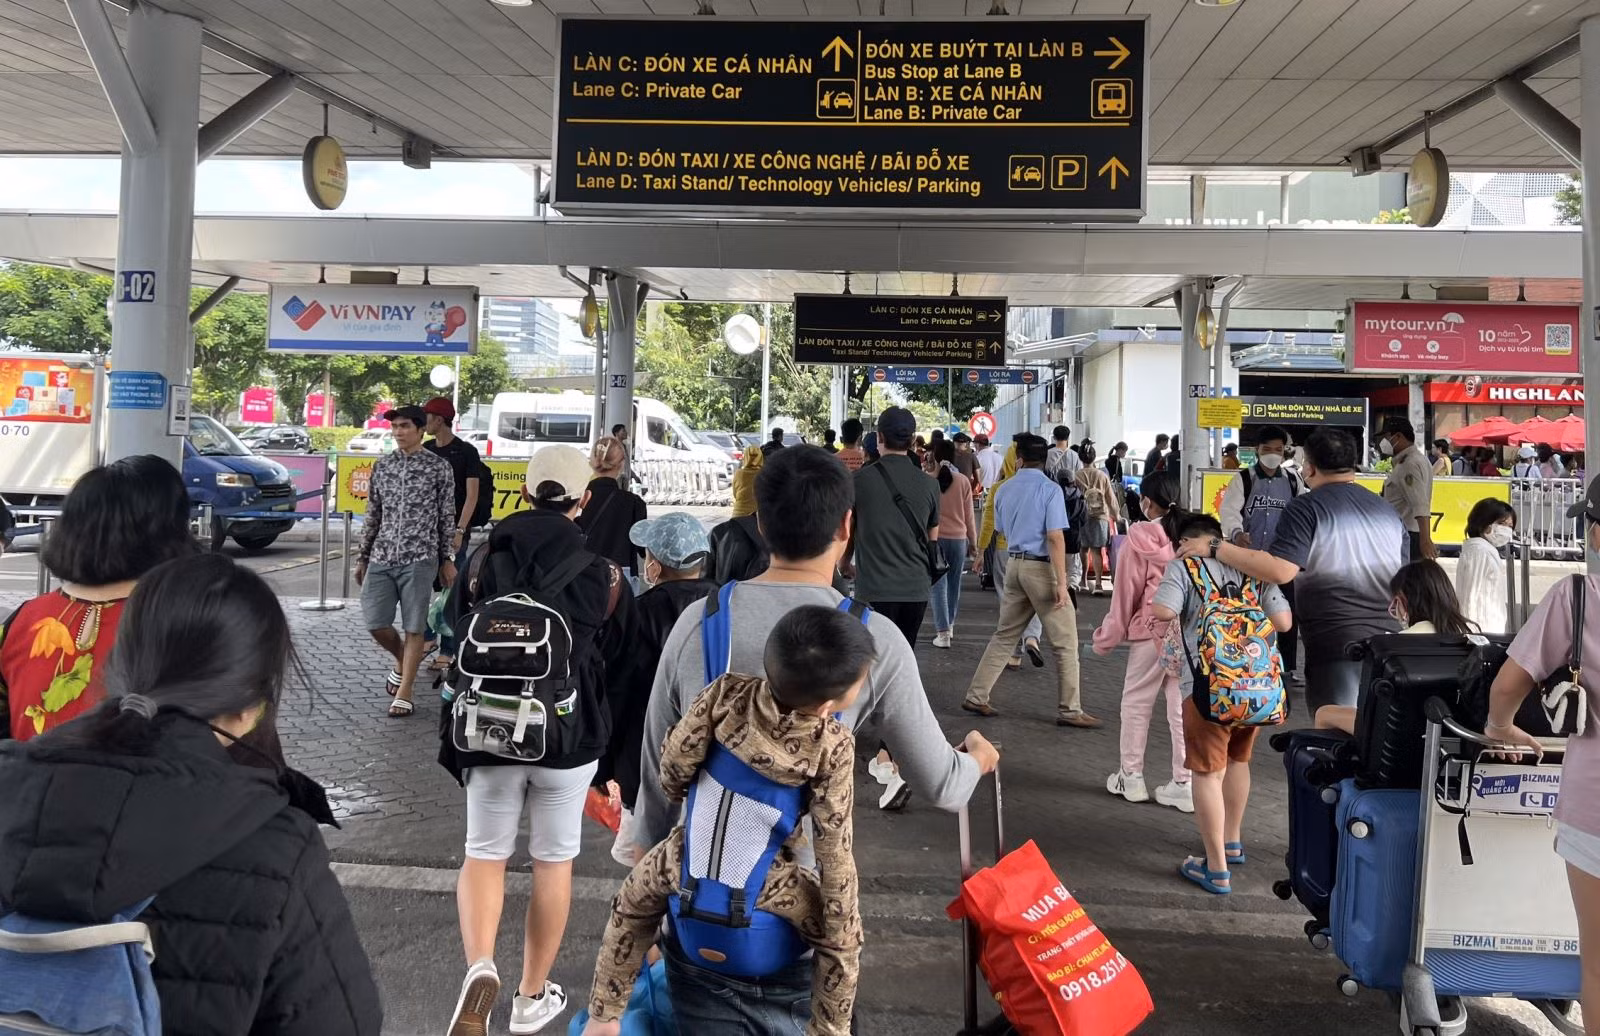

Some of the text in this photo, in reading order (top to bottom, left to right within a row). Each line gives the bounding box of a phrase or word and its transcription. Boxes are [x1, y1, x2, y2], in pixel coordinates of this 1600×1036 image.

[866, 38, 1083, 60] ĐÓN XE BUÝT TẠI LÀN B
[573, 52, 812, 74] LÀN C: ĐÓN XE CÁ NHÂN
[865, 63, 1021, 82] Bus Stop at Lane B
[573, 82, 742, 99] Lane C: Private Car
[865, 82, 1042, 101] LÀN B: XE CÁ NHÂN
[864, 105, 1022, 120] Lane B: Private Car
[576, 148, 611, 167] LÀN
[616, 152, 633, 168] D:
[639, 148, 675, 168] ĐÓN
[680, 153, 718, 168] TAXI
[734, 153, 755, 169] XE
[761, 150, 811, 170] CÔNG
[817, 151, 865, 173] NGHỆ
[882, 152, 910, 170] BÃI
[916, 148, 941, 170] ĐỖ
[946, 155, 969, 170] XE
[576, 174, 981, 197] Lane D: Taxi Stand/ Technology Vehicles/ Parking
[330, 304, 416, 321] Ví VNPAY
[900, 317, 918, 325] Lane
[920, 317, 929, 325] C:
[931, 317, 957, 325] Private
[1365, 318, 1446, 334] mytour.vn
[837, 339, 855, 347] TAXI
[875, 339, 898, 348] CÔNG
[961, 341, 972, 349] XE
[1478, 330, 1496, 342] 10
[872, 349, 911, 358] Technology
[946, 351, 972, 359] Parking
[1522, 774, 1559, 783] BIZMAN
[1022, 895, 1059, 922] MUA
[1037, 945, 1062, 961] TRANG
[1046, 969, 1064, 982] BAO
